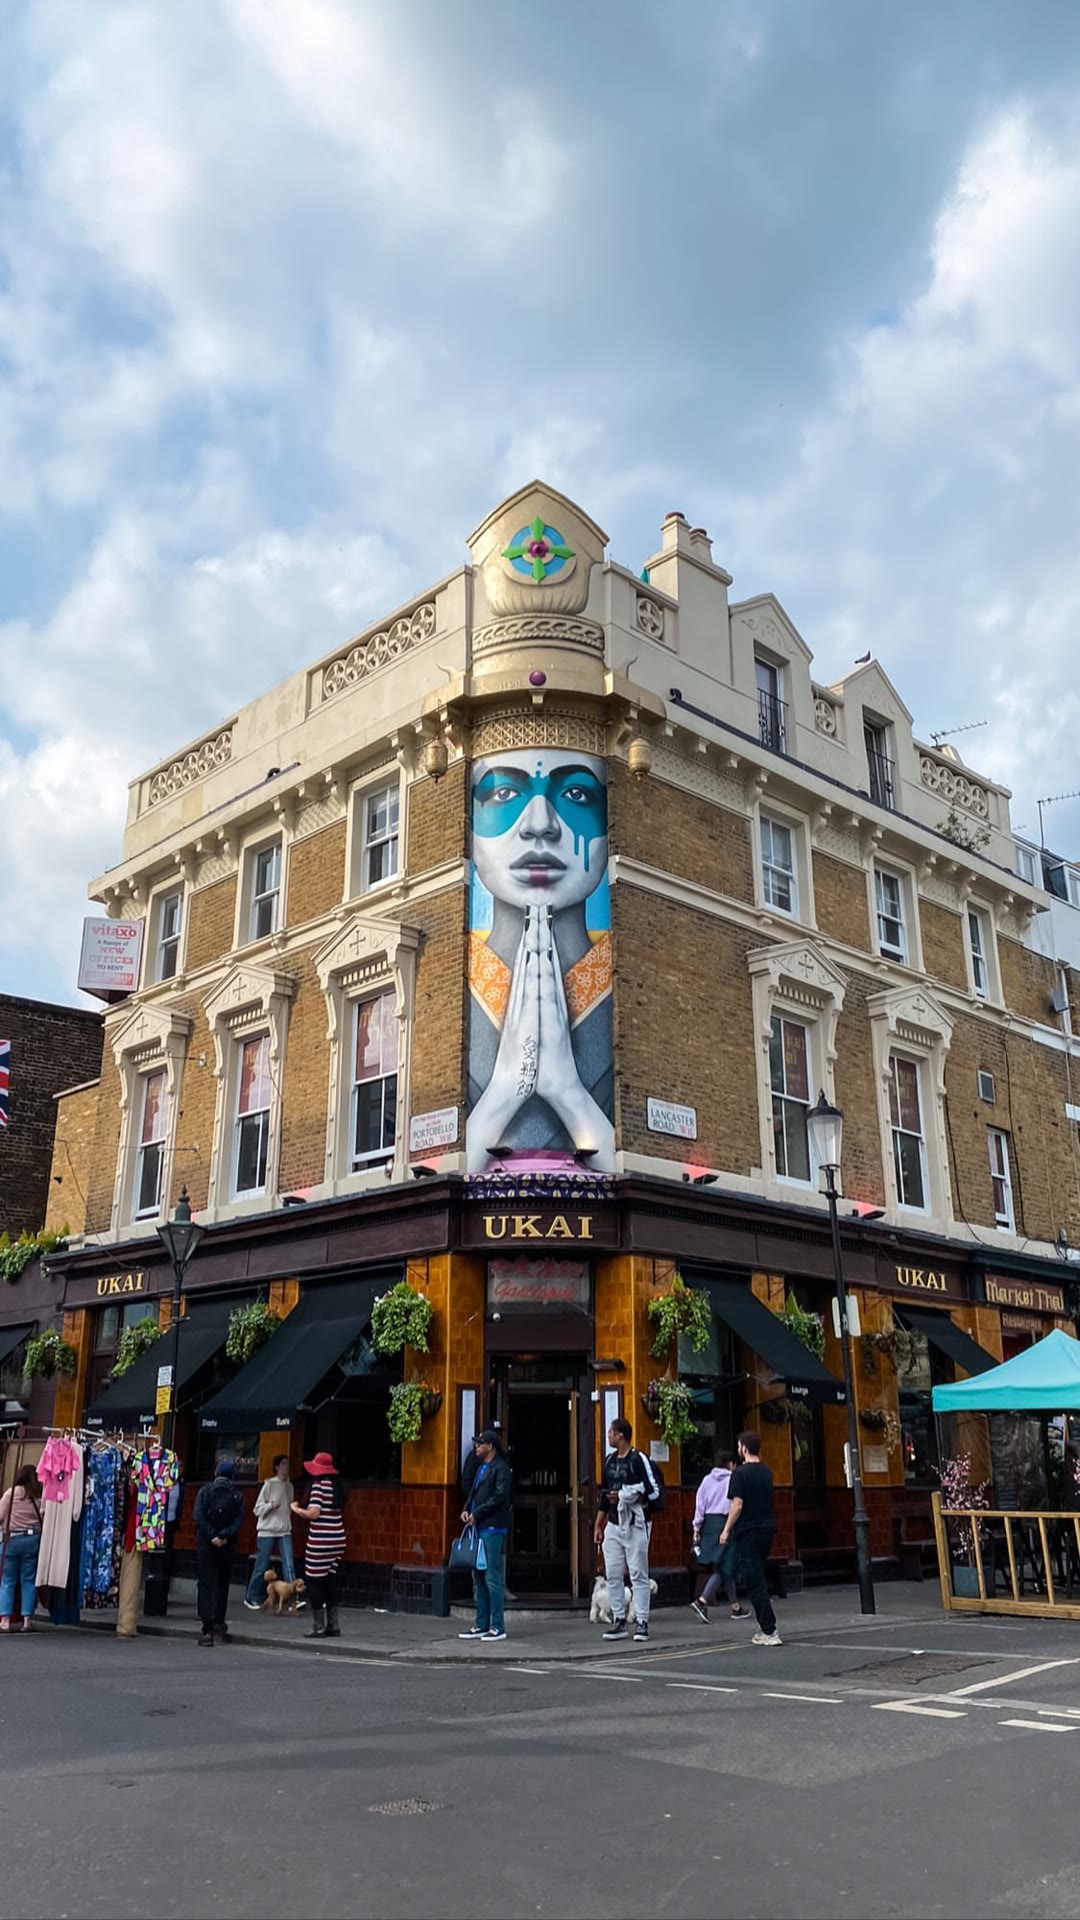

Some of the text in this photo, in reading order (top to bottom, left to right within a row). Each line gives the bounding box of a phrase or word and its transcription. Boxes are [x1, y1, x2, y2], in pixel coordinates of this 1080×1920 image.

[92, 923, 137, 938] vitaxo
[88, 955, 134, 965] OFFICES
[99, 947, 125, 955] NEW
[651, 1108, 694, 1127] LANCASTER
[653, 1119, 675, 1131] ROAD
[413, 1122, 454, 1140] PORTOBELLO
[415, 1137, 434, 1149] ROAD
[482, 1215, 593, 1239] UKAI
[96, 1272, 144, 1296] UKAI
[895, 1265, 947, 1291] UKAI
[985, 1279, 1033, 1307] Market
